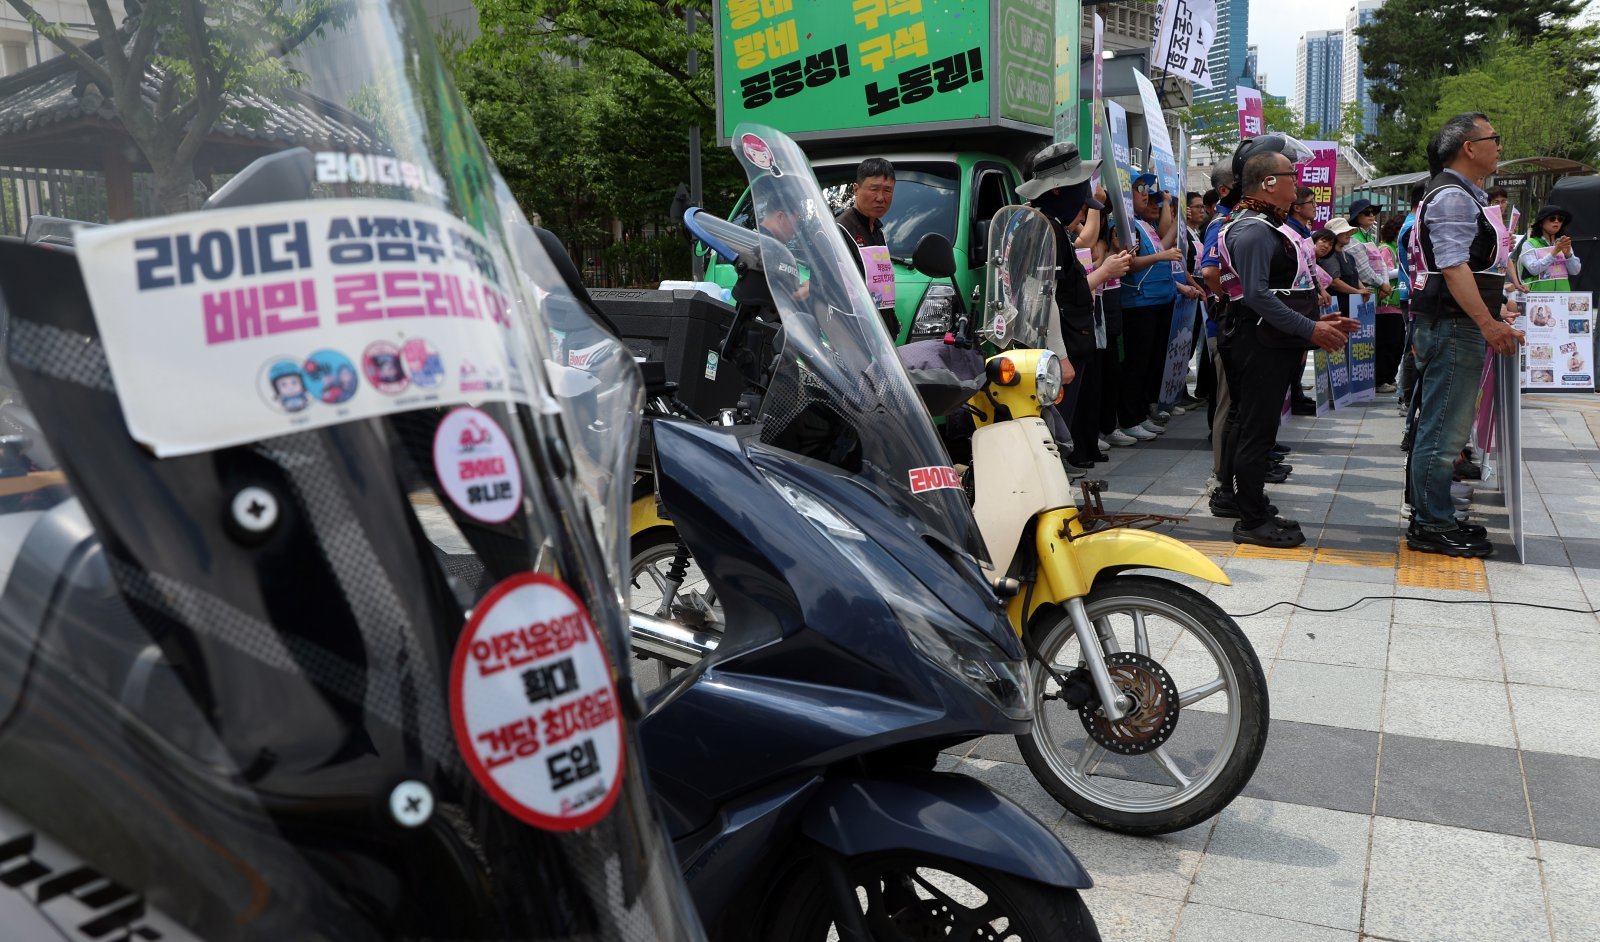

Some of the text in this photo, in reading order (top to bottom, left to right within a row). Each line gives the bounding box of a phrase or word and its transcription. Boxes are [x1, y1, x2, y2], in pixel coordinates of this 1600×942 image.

[729, 0, 795, 31] 동네
[852, 0, 923, 31] 구석
[733, 18, 800, 70] 방네
[859, 21, 930, 73] 구석
[740, 43, 852, 110] 공공성!
[864, 46, 985, 117] 노동권!
[1302, 166, 1330, 184] 도급제
[135, 219, 312, 292] 라이더
[327, 217, 444, 266] 상점주
[203, 278, 320, 346] 배민
[590, 290, 648, 299] TOPBOX
[458, 459, 508, 482] 라이더
[466, 479, 514, 506] 유니온
[471, 613, 587, 678] 안전운임제
[476, 686, 617, 770] 건당 최저임금
